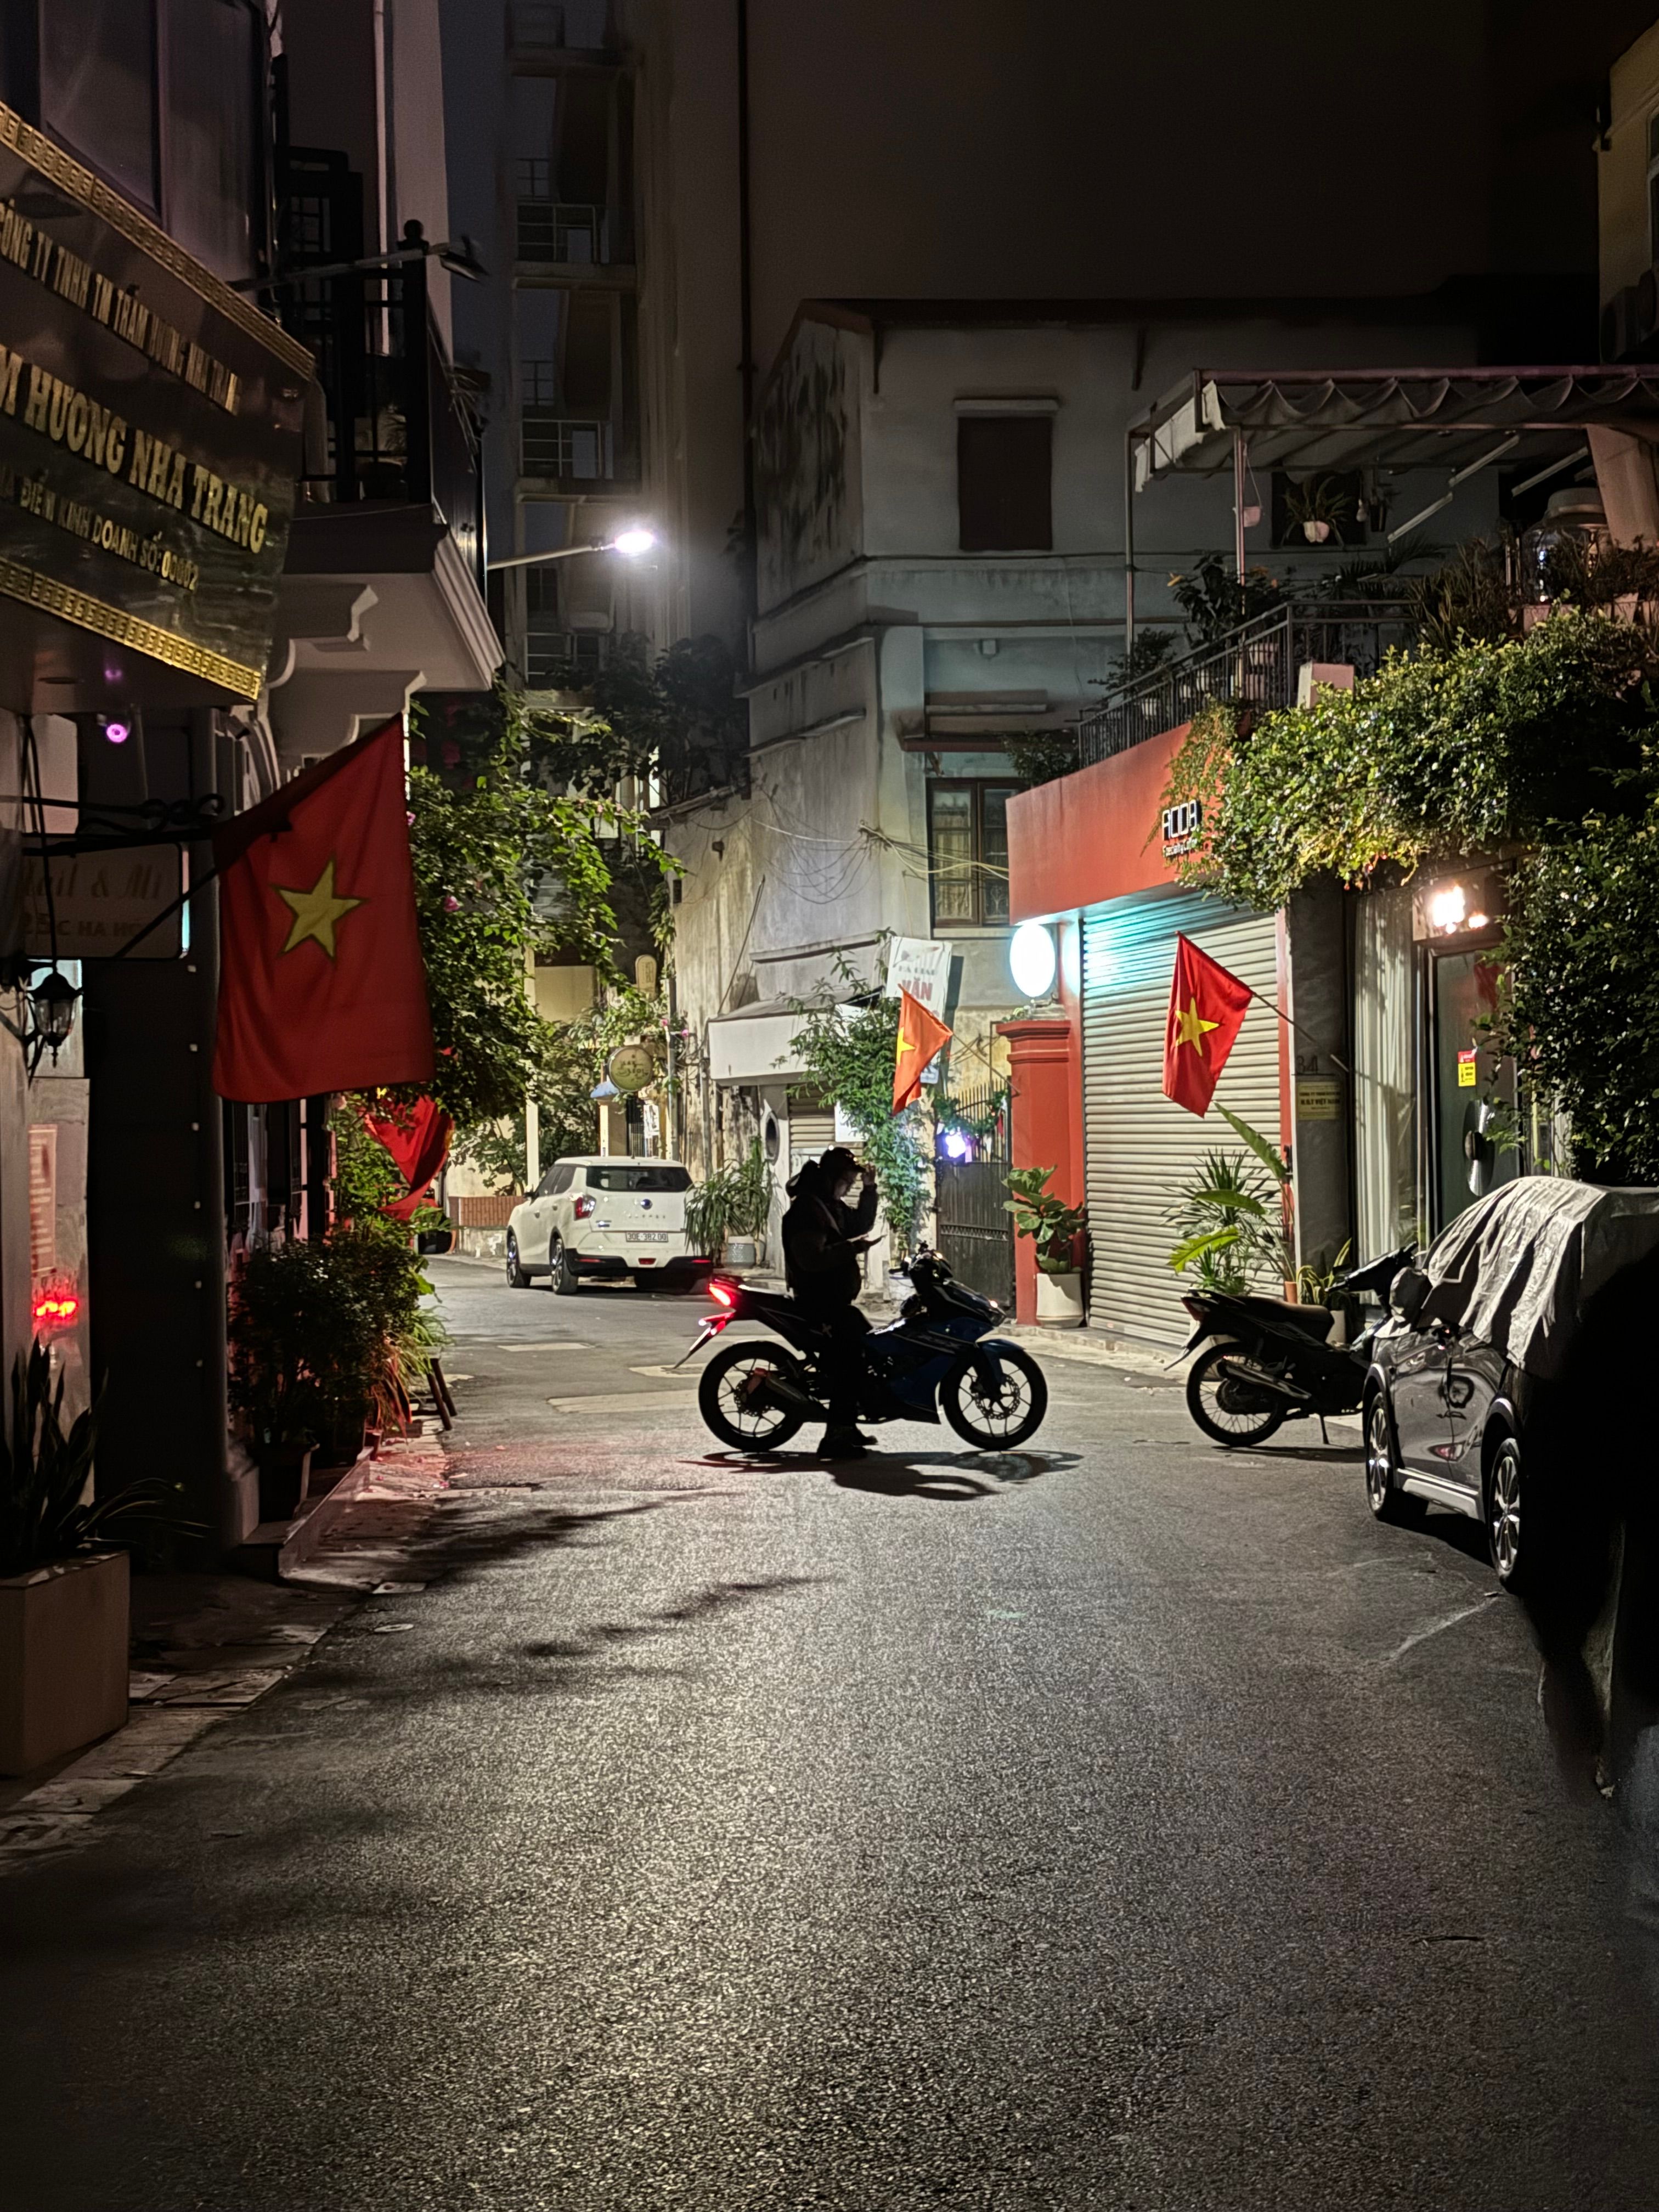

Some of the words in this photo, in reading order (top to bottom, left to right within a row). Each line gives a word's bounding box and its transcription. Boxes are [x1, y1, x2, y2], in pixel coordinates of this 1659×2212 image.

[129, 429, 186, 510] NHA
[191, 464, 268, 554] TRANG
[92, 515, 139, 562] DOANH
